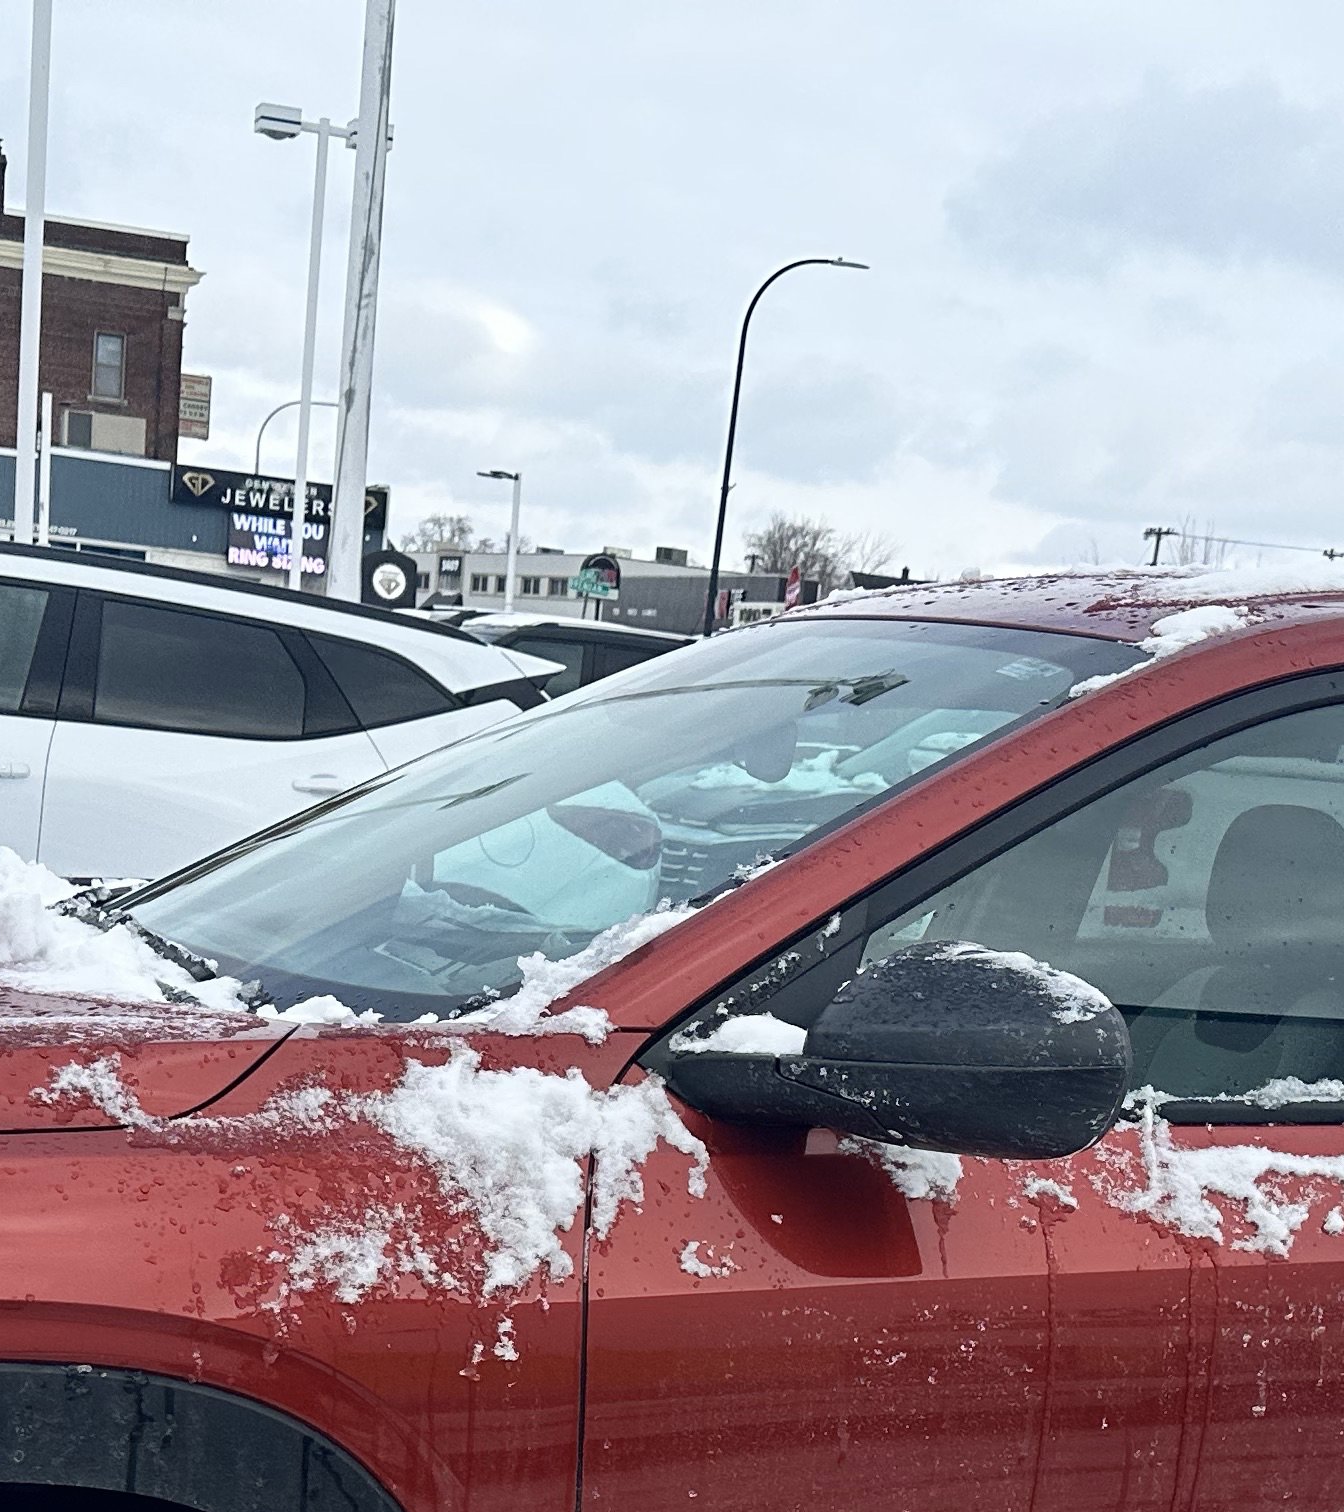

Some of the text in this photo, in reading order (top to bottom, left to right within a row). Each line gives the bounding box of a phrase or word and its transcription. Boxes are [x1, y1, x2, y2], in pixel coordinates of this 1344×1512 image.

[232, 513, 324, 541] WHILE OU
[227, 546, 325, 574] RING SIZNG
